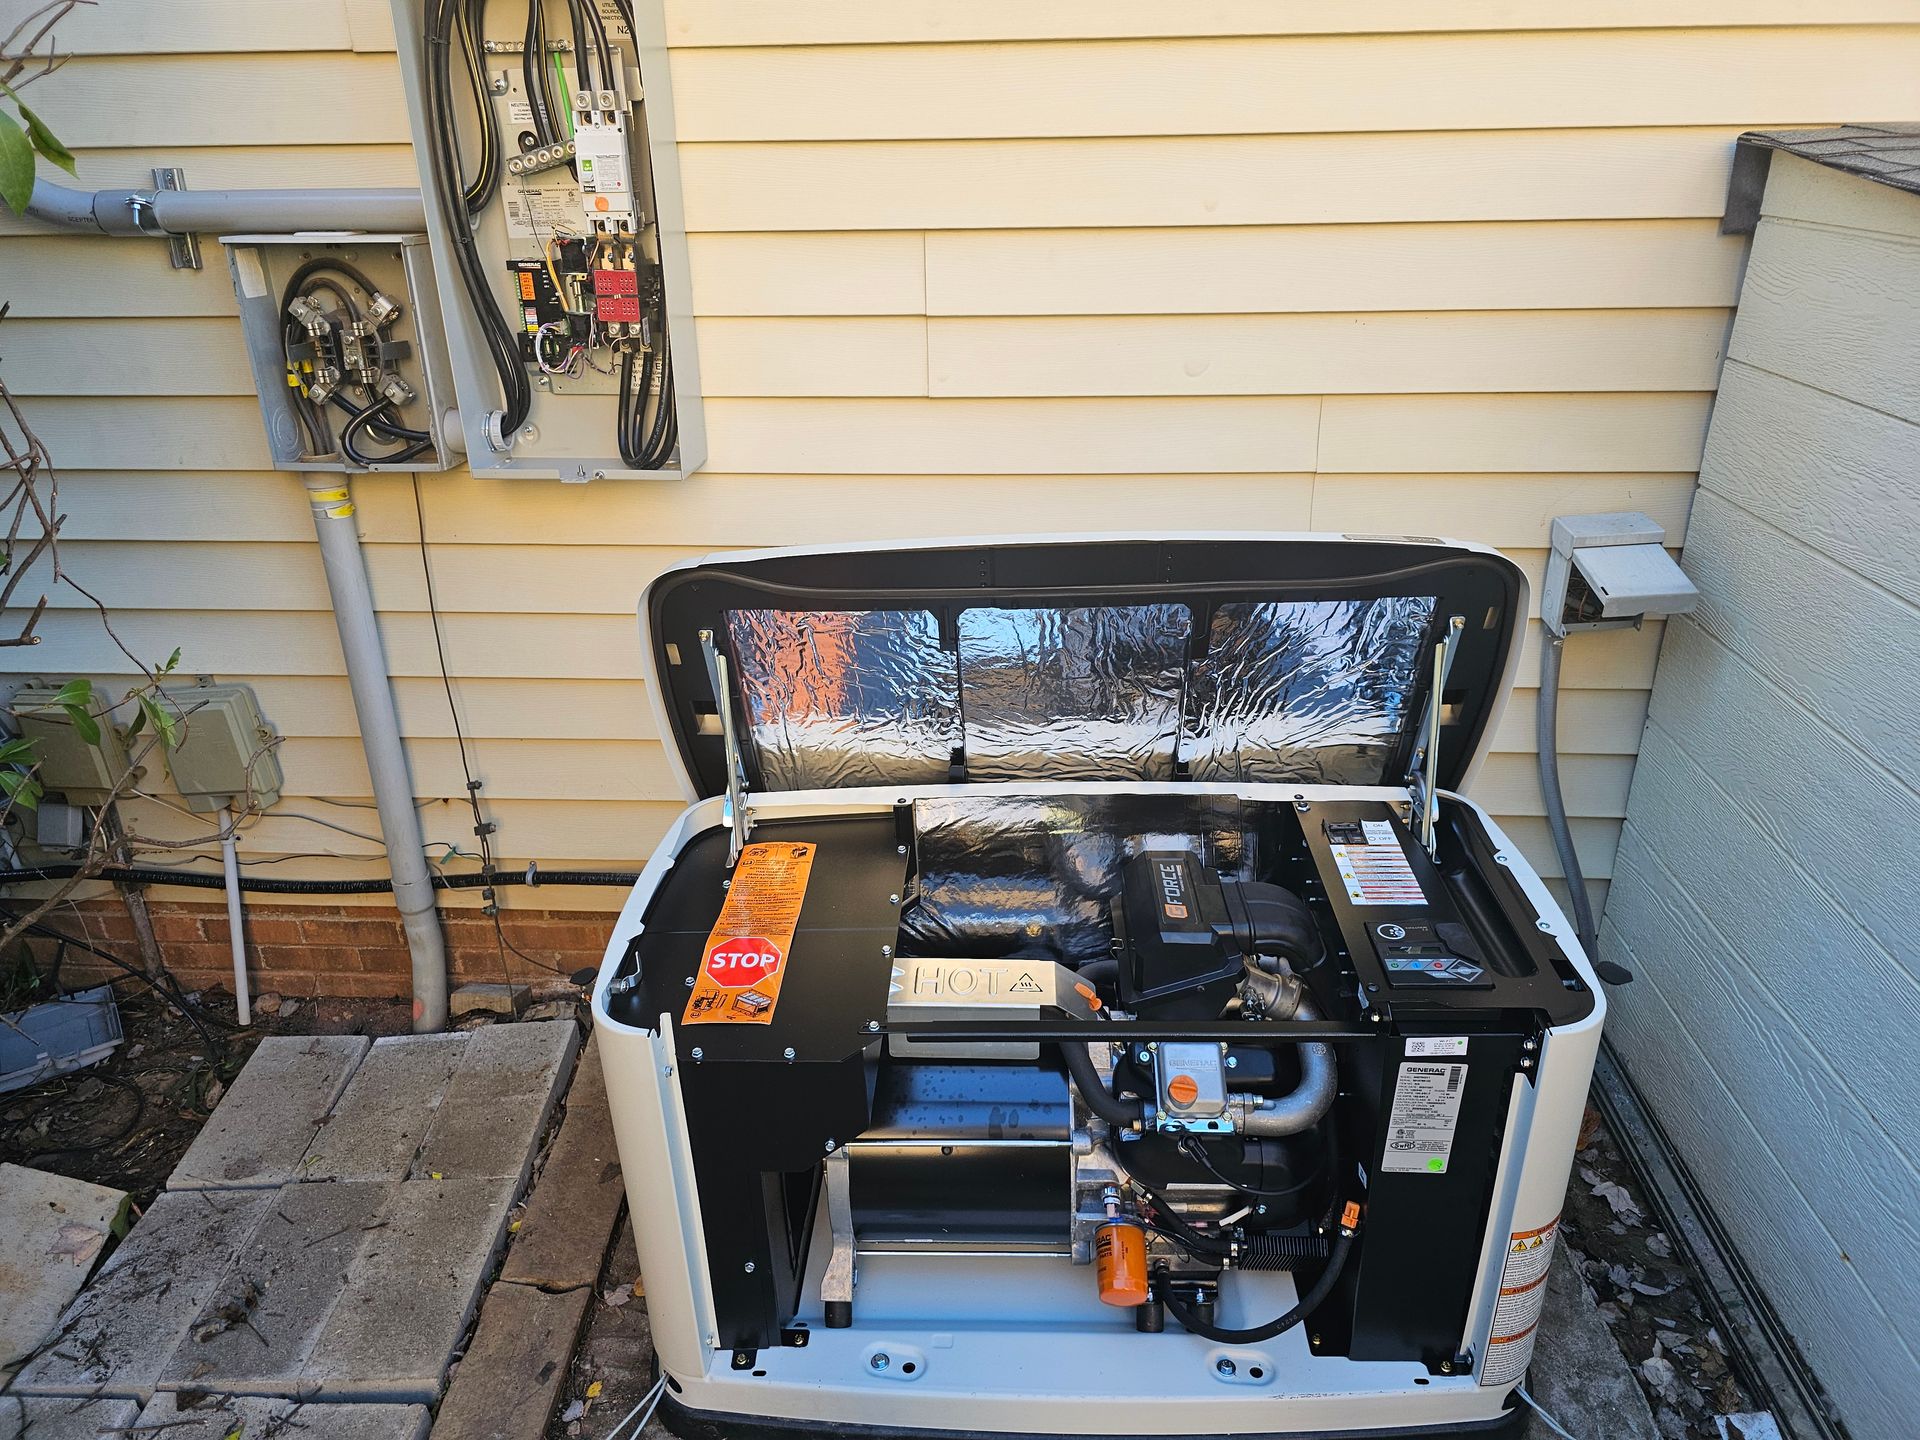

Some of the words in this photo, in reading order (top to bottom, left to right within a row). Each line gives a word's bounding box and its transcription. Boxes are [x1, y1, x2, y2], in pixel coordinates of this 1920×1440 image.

[1159, 863, 1183, 905] FORCE
[711, 953, 775, 969] STOP
[913, 967, 1009, 996] HOT
[1168, 1059, 1217, 1067] GENERAC
